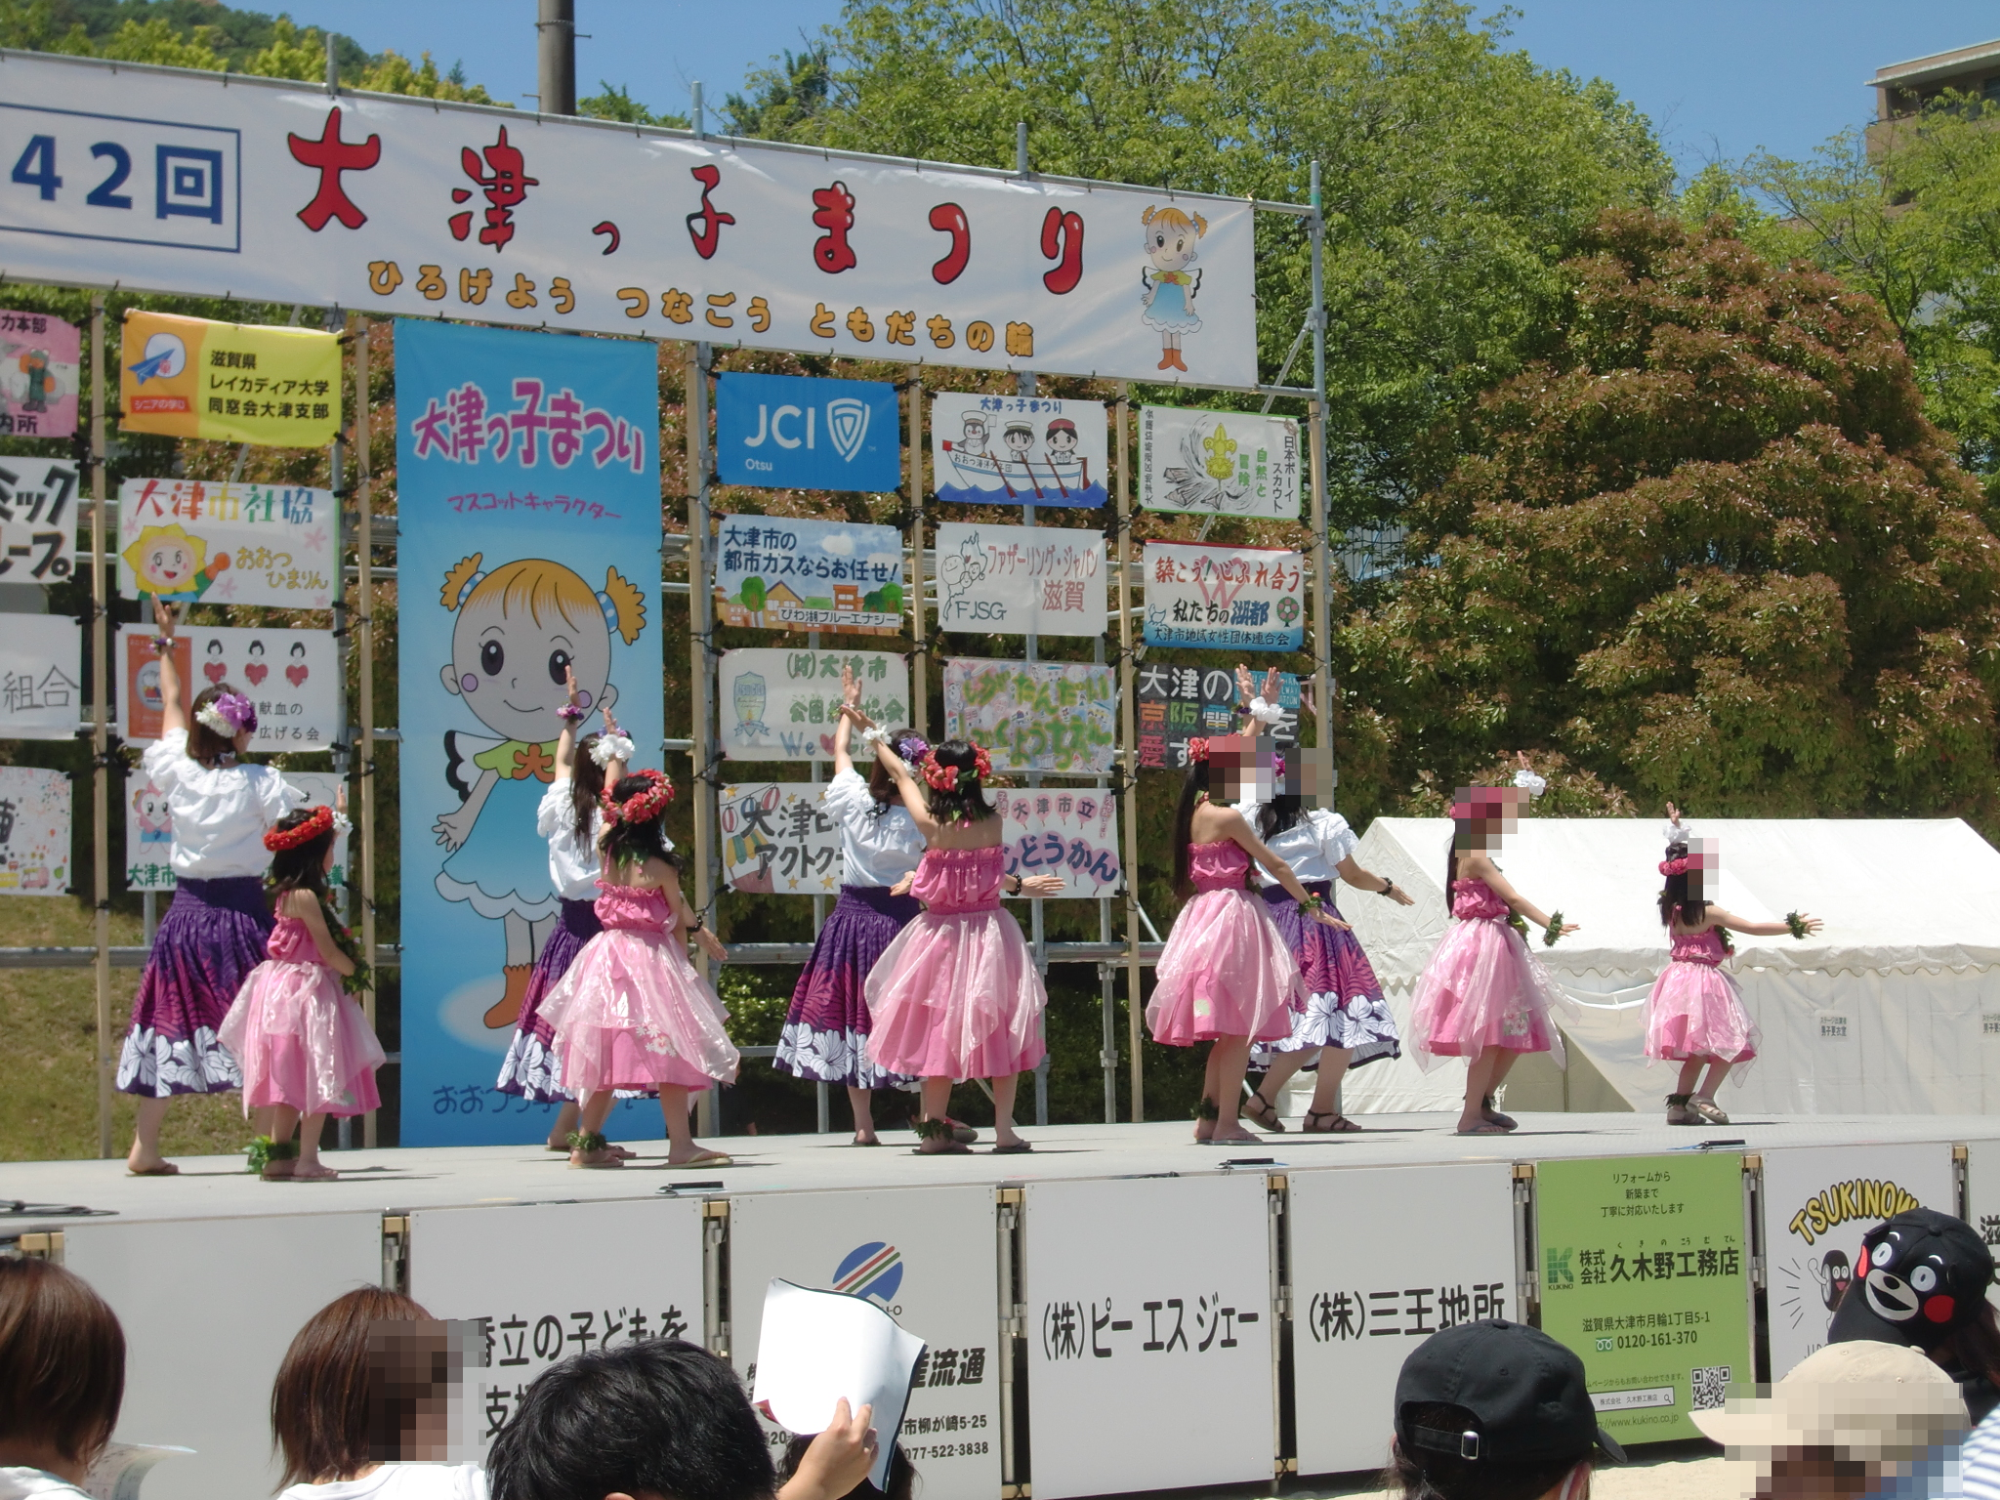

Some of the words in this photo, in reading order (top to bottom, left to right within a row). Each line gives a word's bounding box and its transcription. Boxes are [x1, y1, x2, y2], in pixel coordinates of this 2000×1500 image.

[11, 133, 224, 226] 42回
[287, 105, 1084, 296] 大津っ子まつり
[367, 260, 576, 314] ひろげよう
[616, 286, 772, 333] つなごう
[810, 303, 1034, 358] ともだちの輪
[210, 349, 256, 370] 滋賀県
[210, 374, 330, 396] レイカディア大学
[209, 396, 330, 420] 同窓会大津支部
[980, 396, 1063, 414] 大津っ子まつり
[412, 378, 645, 475] 大津っ子まつり
[744, 404, 816, 450] JCI
[745, 458, 773, 472] Otsu
[1256, 447, 1268, 498] 自然と
[1283, 436, 1296, 503] 日本ボーイ
[1272, 462, 1283, 513] スカウト
[134, 478, 314, 525] 大津市社協
[447, 491, 622, 520] マスコットキャラクター
[724, 525, 797, 551] 大津市の
[236, 546, 293, 570] おおつ
[724, 549, 899, 583] 都市ガスならお任せ!
[988, 543, 1099, 578] ファザーリング・ジャパン
[266, 567, 329, 590] ひまりん
[1042, 580, 1085, 613] 滋賀
[955, 601, 1007, 621] FJSG
[1172, 598, 1271, 627] 私たちの湖都
[1154, 628, 1290, 647] 大津市地域女性団体連合会
[3, 664, 81, 714] 組合
[1139, 664, 1233, 702] 大津の
[250, 701, 304, 716] 献血の
[1139, 700, 1299, 741] 京阪電を
[250, 725, 320, 741] 広げる会
[780, 732, 817, 757] We
[1139, 734, 1191, 768] 愛す
[1013, 796, 1096, 820] 大津市立
[1612, 1171, 1671, 1184] リフォームから
[1625, 1188, 1659, 1200] 新築まで
[1600, 1203, 1685, 1218] 丁寧に対応いたします
[1609, 1247, 1739, 1283] 久木野工務店
[1309, 1282, 1505, 1343] (株)三王地所
[1582, 1311, 1710, 1333] 滋賀県大津市月輪1丁目5-1
[1617, 1330, 1698, 1349] 0120-161-370
[900, 1414, 988, 1436] 市柳が崎5-25
[1597, 1414, 1680, 1430] p://www.kukino.co.jp
